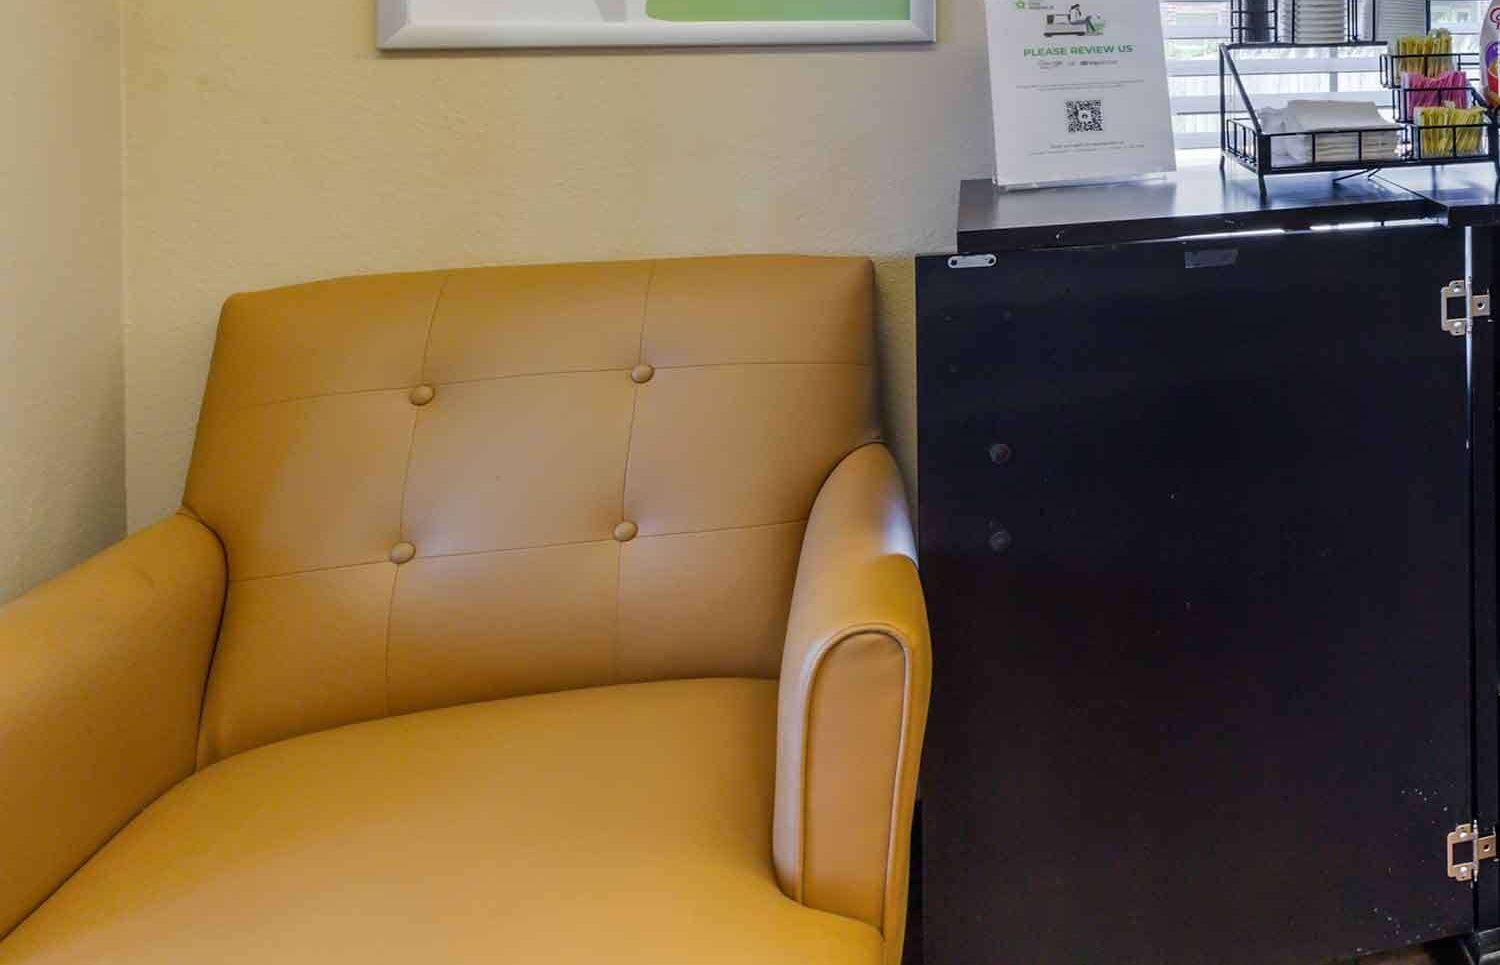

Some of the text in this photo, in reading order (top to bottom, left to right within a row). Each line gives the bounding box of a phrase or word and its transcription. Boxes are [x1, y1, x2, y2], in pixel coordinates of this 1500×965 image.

[1023, 44, 1134, 57] PLEASE REVIEW US
